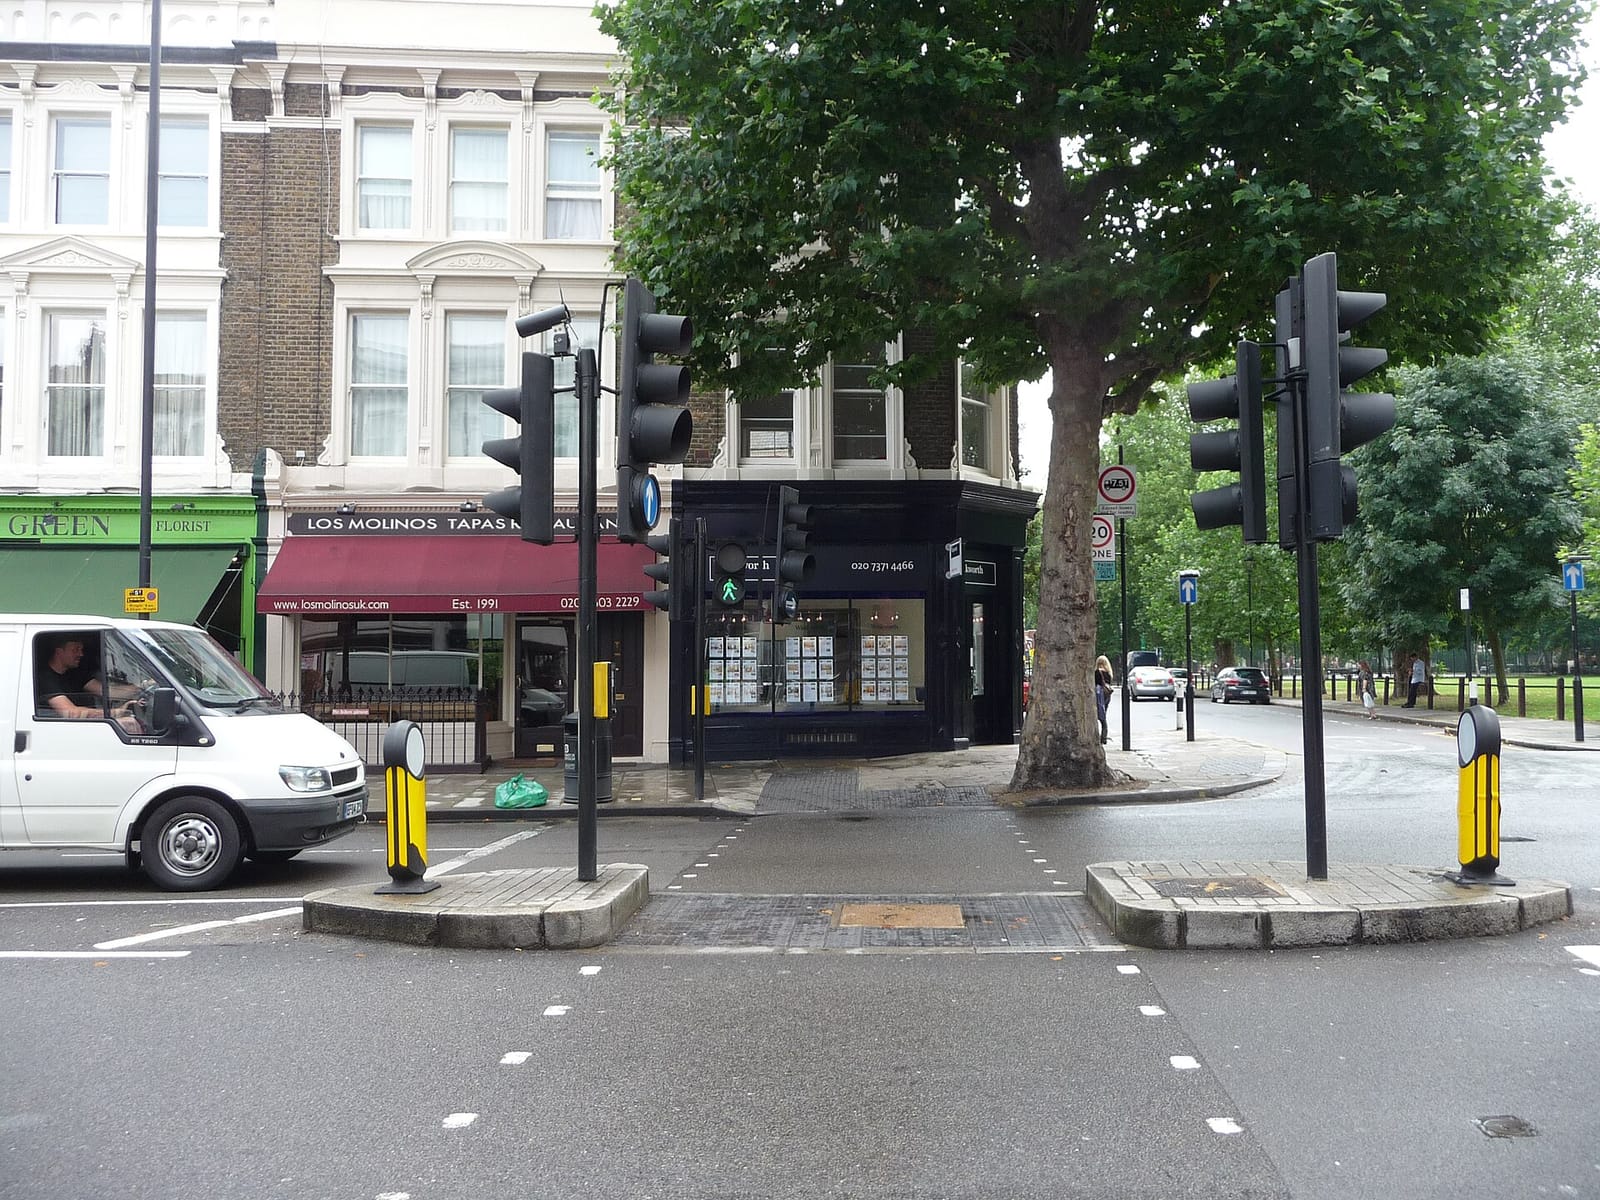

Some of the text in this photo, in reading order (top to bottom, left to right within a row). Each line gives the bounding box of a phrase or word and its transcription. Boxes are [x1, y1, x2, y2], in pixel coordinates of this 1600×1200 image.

[8, 514, 110, 536] GREEN
[156, 520, 211, 532] FLORIST
[307, 518, 344, 530] LOS
[348, 518, 438, 530] MOLINOS
[447, 518, 506, 530] TAPAS
[1092, 549, 1112, 558] ONE
[851, 560, 914, 572] 020 7371 4466
[451, 598, 498, 609] Est. 1991
[615, 596, 640, 608] 2229
